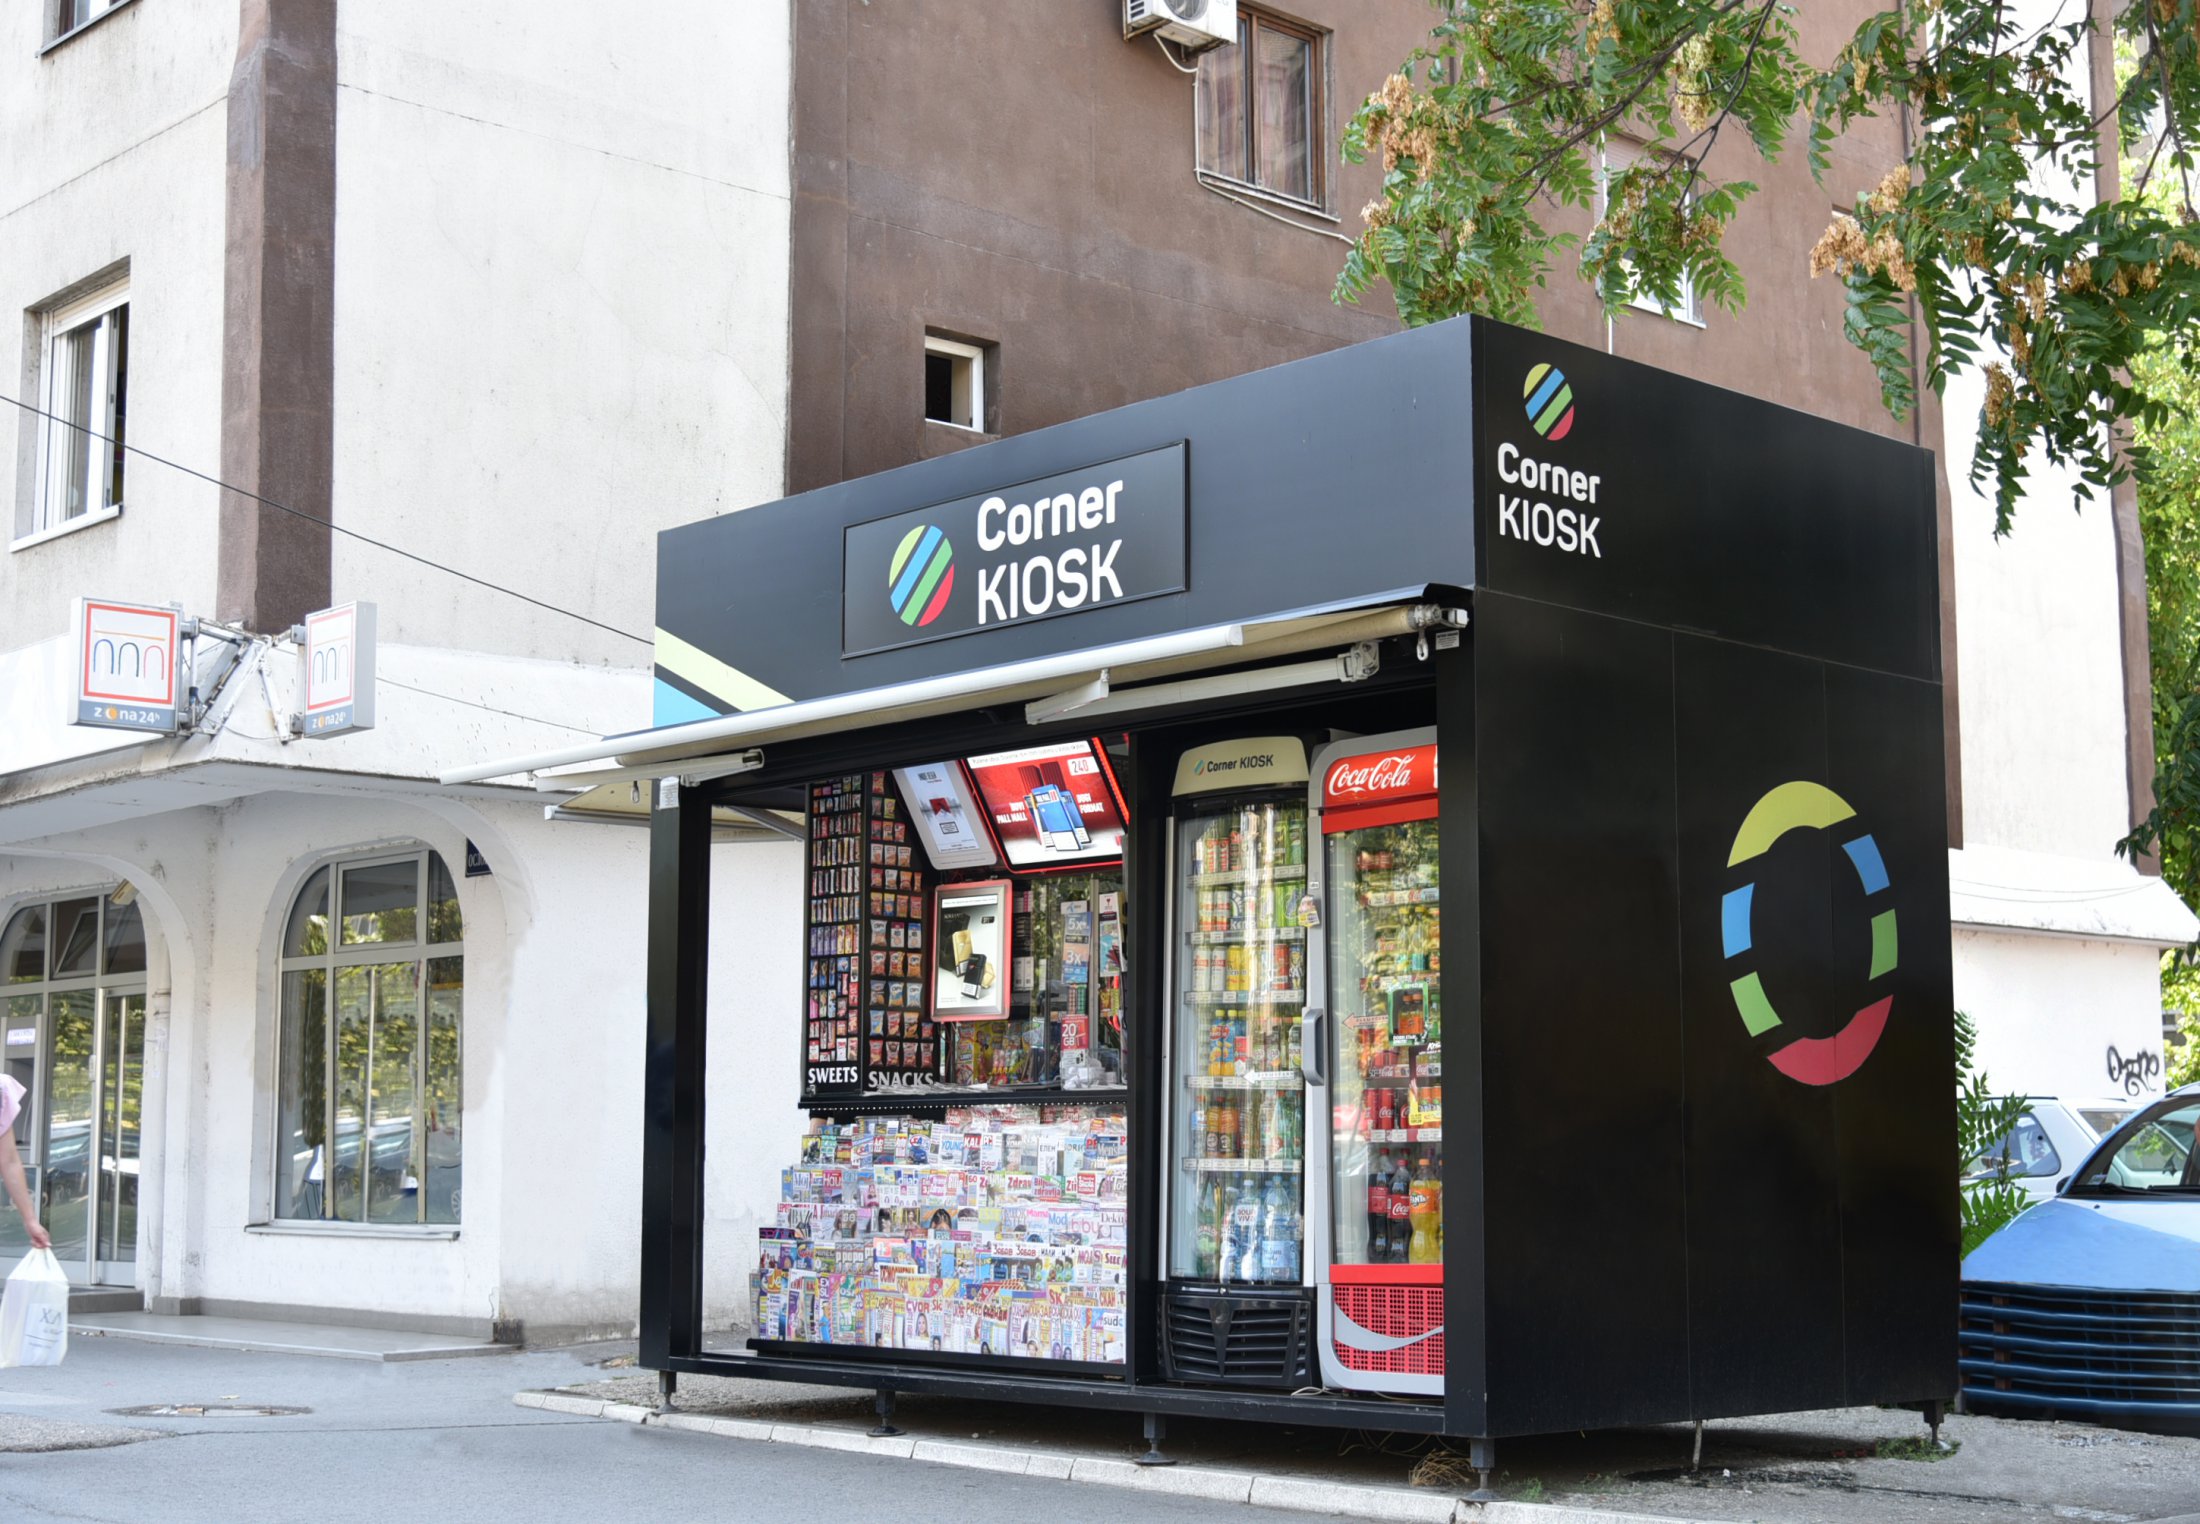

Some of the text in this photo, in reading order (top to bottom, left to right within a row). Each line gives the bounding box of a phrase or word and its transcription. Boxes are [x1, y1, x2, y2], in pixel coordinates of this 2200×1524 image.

[1497, 442, 1601, 504] Corner
[977, 480, 1123, 552] Corner
[1499, 493, 1602, 558] KIOSK
[978, 539, 1123, 625] KIOSK
[1207, 754, 1274, 773] Corner KIOSK
[1329, 754, 1416, 796] Coca-Cola
[1062, 1023, 1077, 1037] 20
[808, 1066, 858, 1084] SWEETS
[868, 1070, 934, 1088] SNACKS
